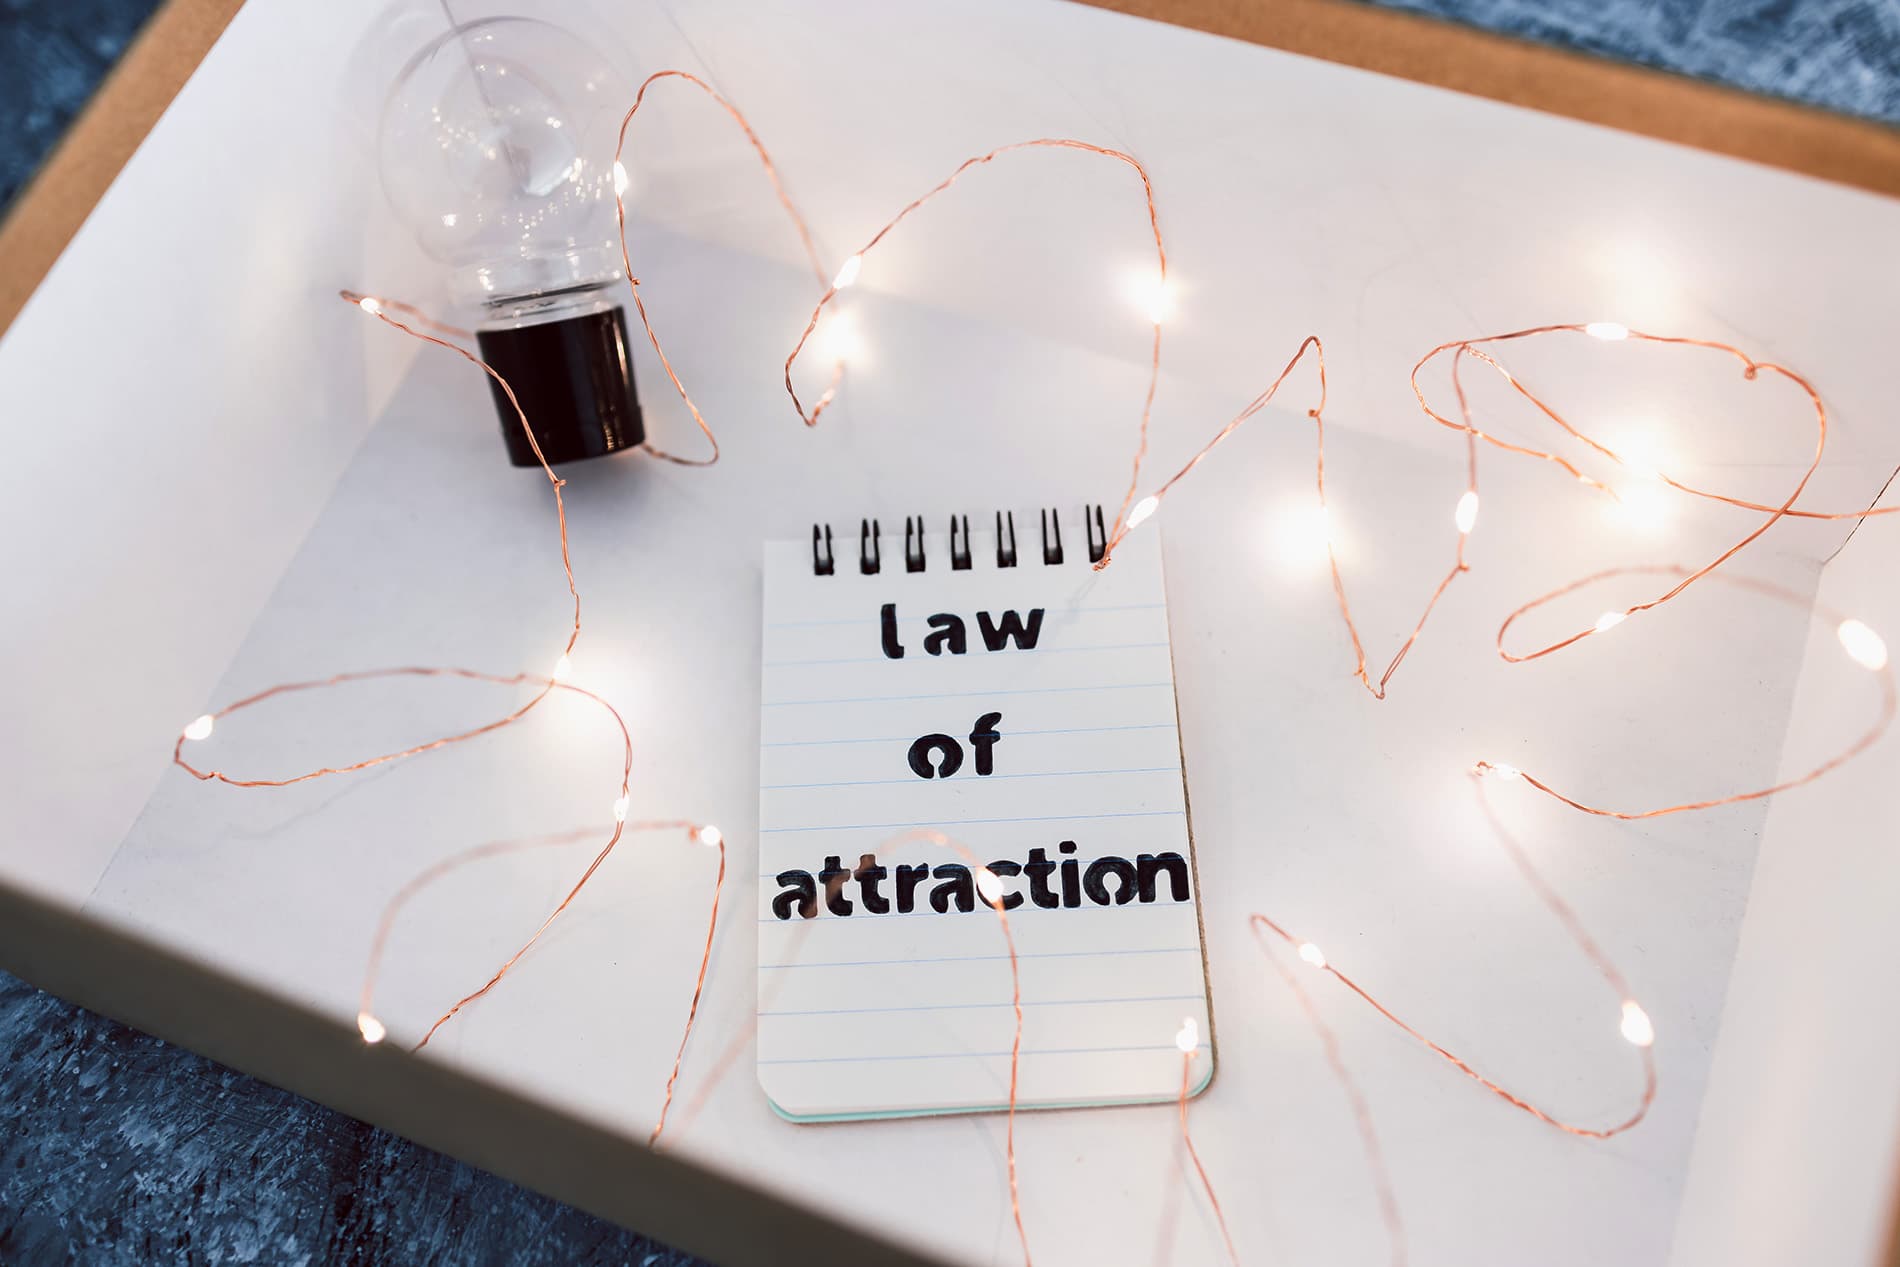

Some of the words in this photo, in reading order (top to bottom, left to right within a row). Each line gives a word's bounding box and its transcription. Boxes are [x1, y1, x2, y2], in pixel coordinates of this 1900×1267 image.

[880, 603, 1045, 659] law
[907, 711, 1002, 780] of
[772, 840, 1190, 920] attraction
